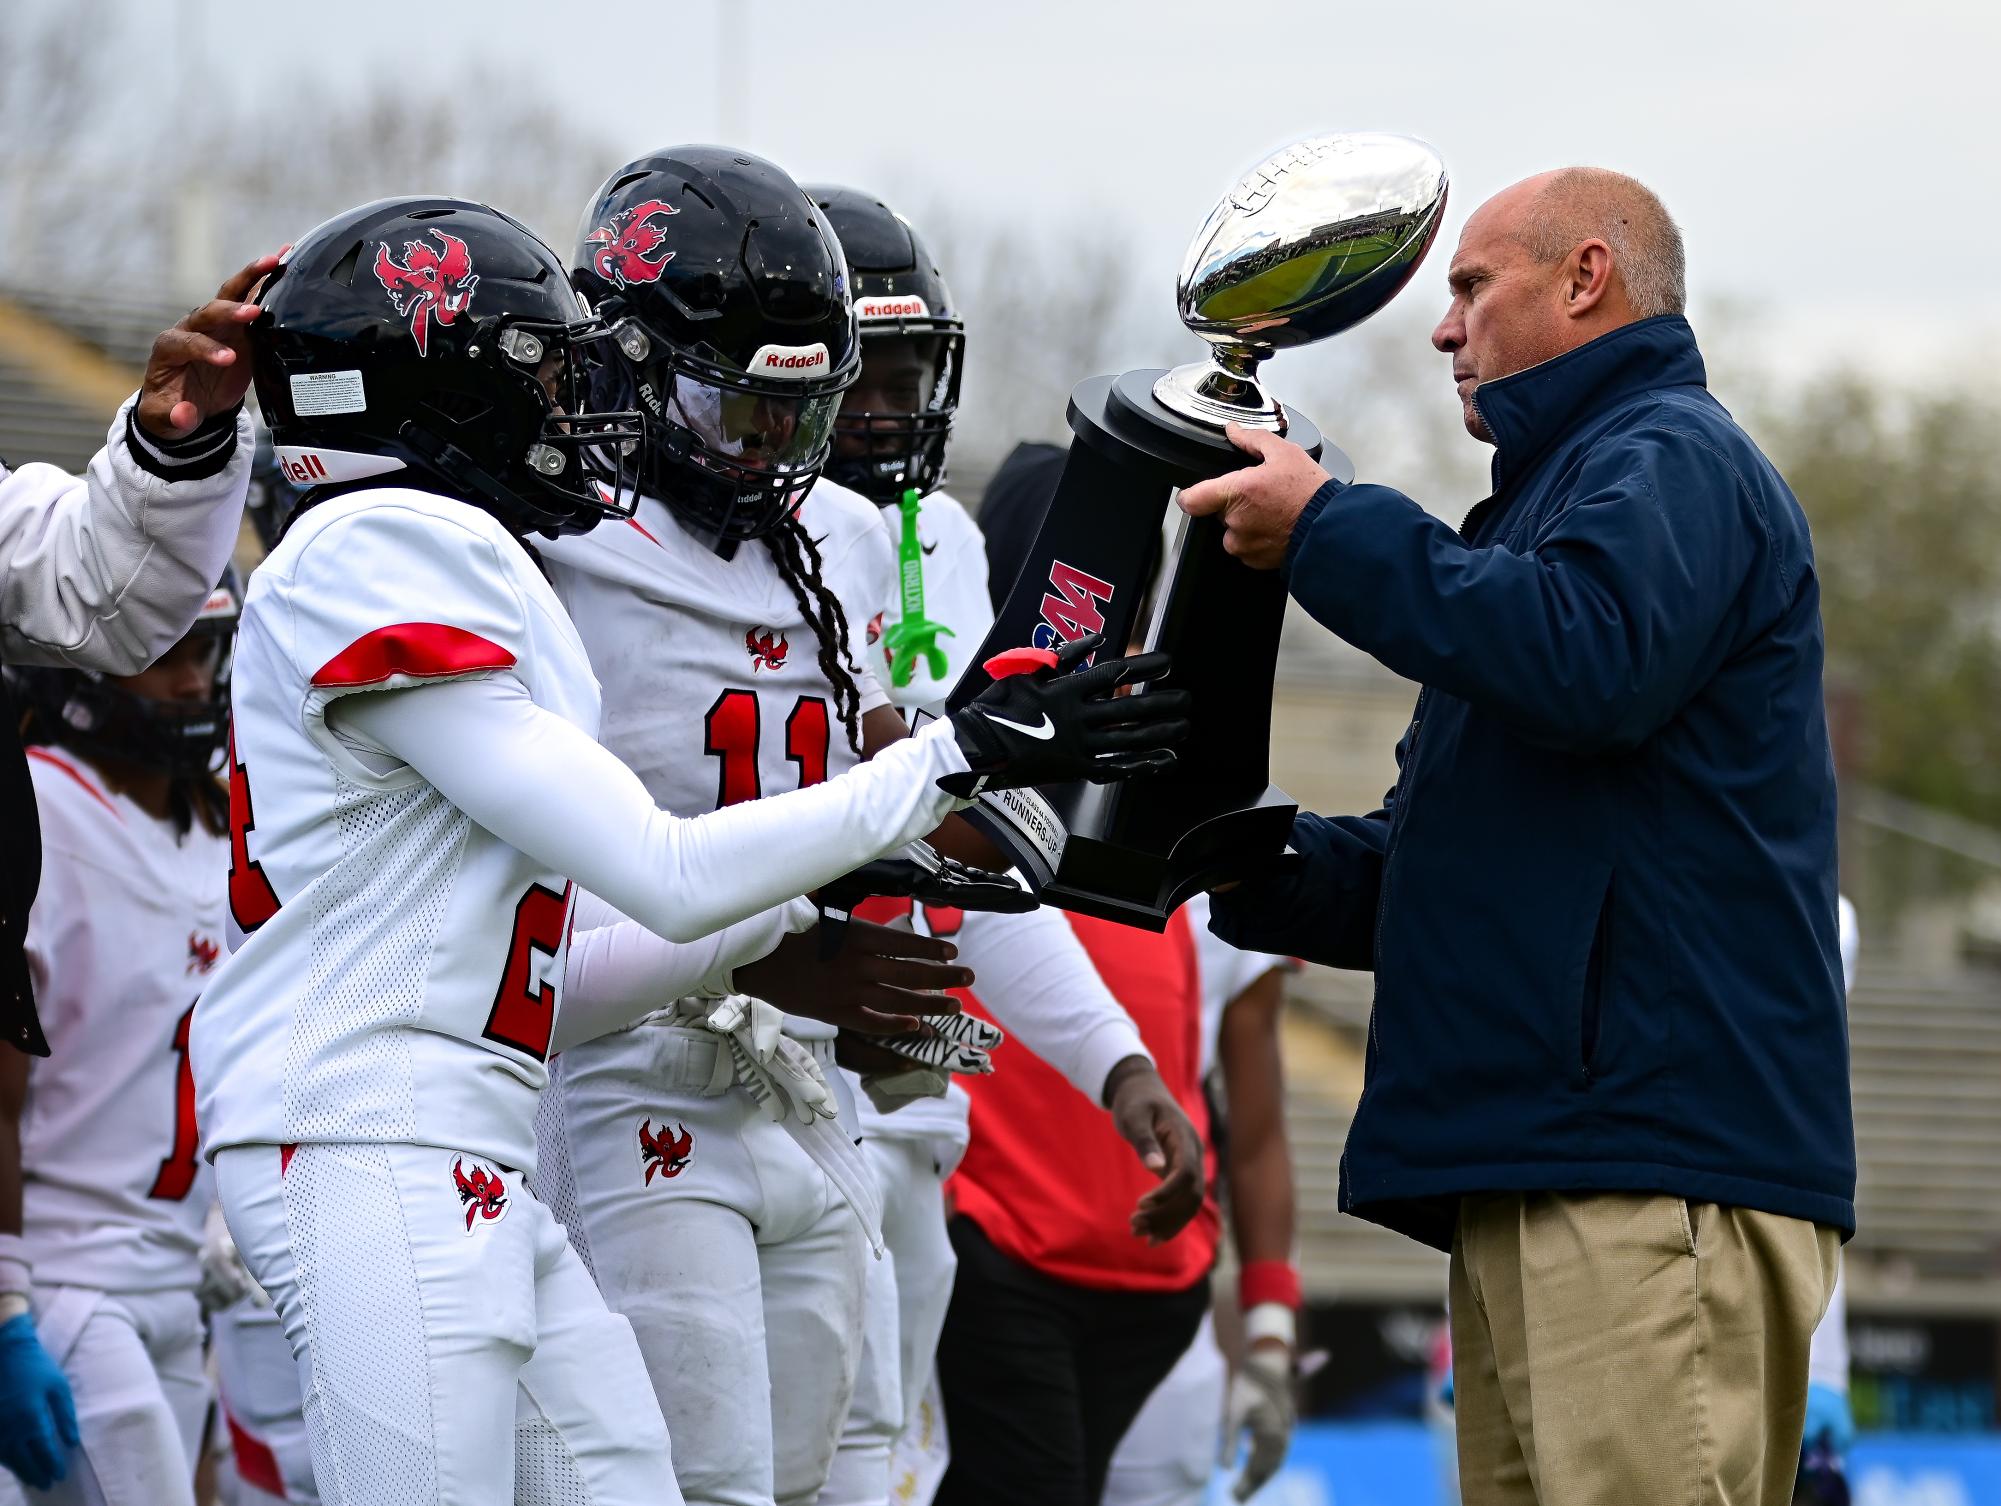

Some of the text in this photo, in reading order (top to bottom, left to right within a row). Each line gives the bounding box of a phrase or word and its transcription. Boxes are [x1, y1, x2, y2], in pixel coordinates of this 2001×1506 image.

[864, 302, 921, 316] Riddell
[766, 352, 824, 368] Riddell
[281, 454, 326, 482] dell
[903, 559, 923, 614] NXTRND
[704, 688, 830, 811] 11
[1003, 790, 1058, 854] RUNNERS-UP
